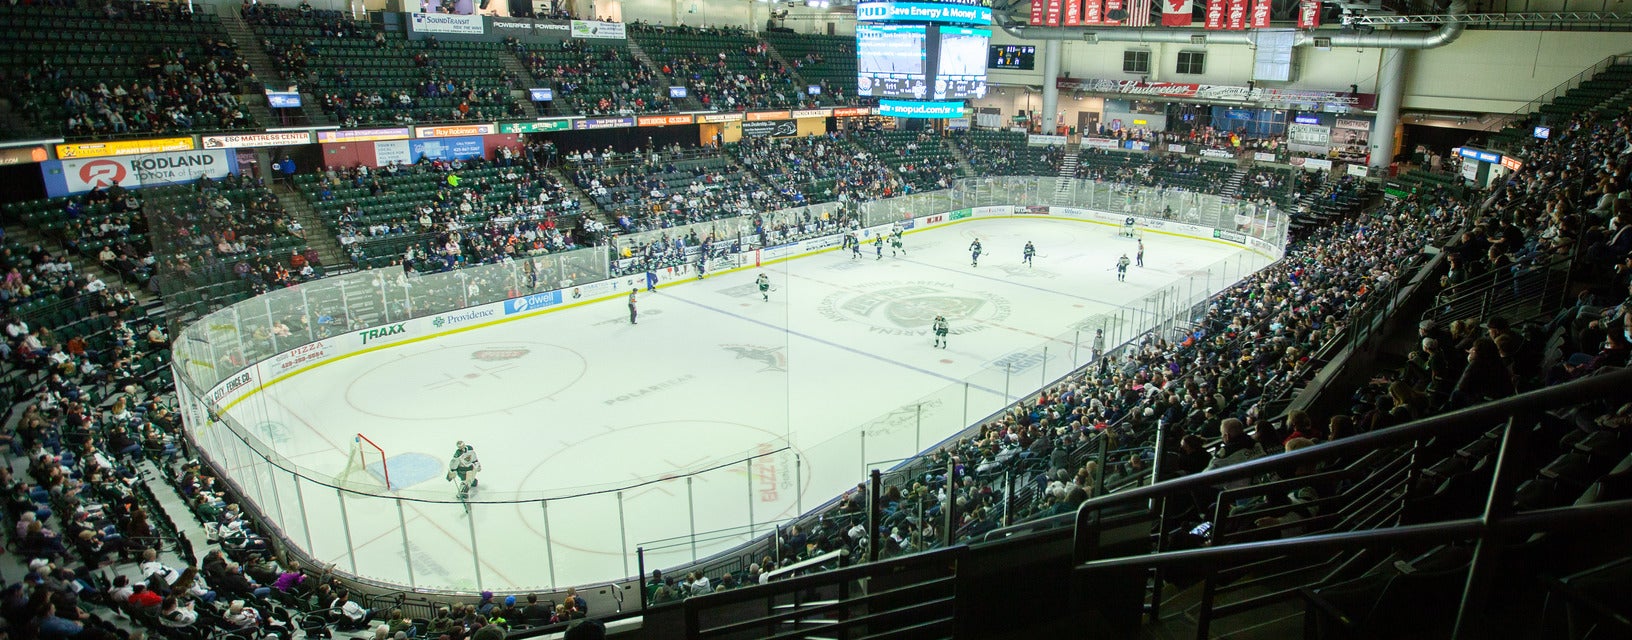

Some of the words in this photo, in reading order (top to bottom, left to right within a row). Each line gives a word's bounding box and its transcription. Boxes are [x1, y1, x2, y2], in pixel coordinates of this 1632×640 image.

[858, 6, 887, 17] PUD
[890, 6, 909, 16] Save
[911, 6, 940, 18] Energy
[942, 8, 950, 17] &
[950, 8, 976, 20] Money!
[874, 79, 880, 87] 2
[949, 81, 953, 89] 2
[1119, 80, 1190, 94] Budweiser
[895, 105, 950, 115] snopud.com/sr
[131, 155, 213, 171] RODLAND
[135, 171, 175, 180] TOYOTA
[528, 292, 554, 305] dwell
[447, 308, 494, 324] Providence
[359, 322, 406, 344] TRAXX
[291, 342, 324, 356] PIZZA
[214, 386, 224, 401] CITY
[226, 376, 241, 391] FENCE
[242, 372, 252, 382] CO.
